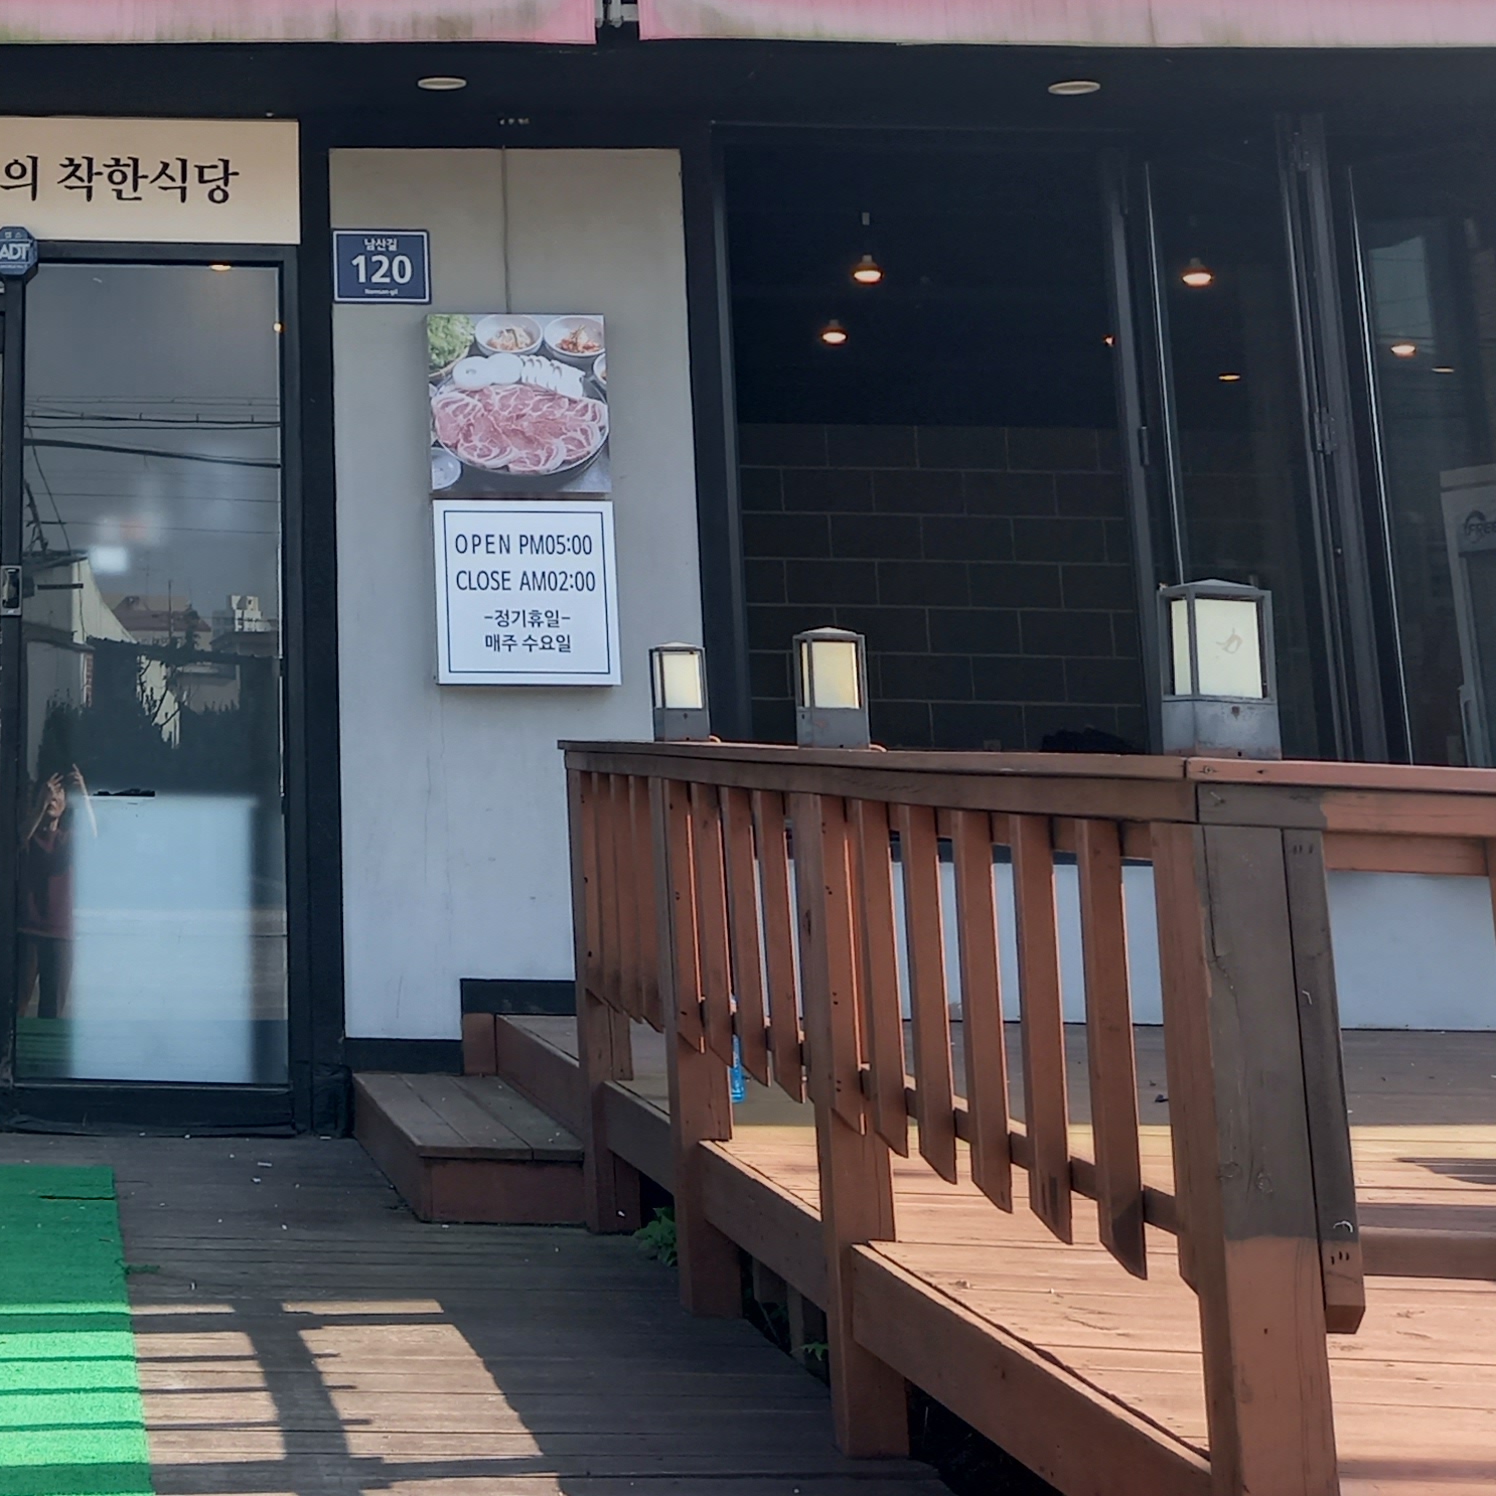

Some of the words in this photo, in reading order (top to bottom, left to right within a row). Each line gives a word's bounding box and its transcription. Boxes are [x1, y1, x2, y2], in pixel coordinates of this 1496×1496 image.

[56, 156, 241, 204] 착한식당
[364, 238, 398, 252] 남산길
[351, 254, 412, 284] 120
[455, 533, 511, 556] OPEN
[518, 533, 593, 556] PM05:00
[456, 570, 512, 593] CLOSE
[519, 570, 596, 593] AM02:00
[484, 633, 518, 654] 매주
[522, 633, 572, 654] 수요일
